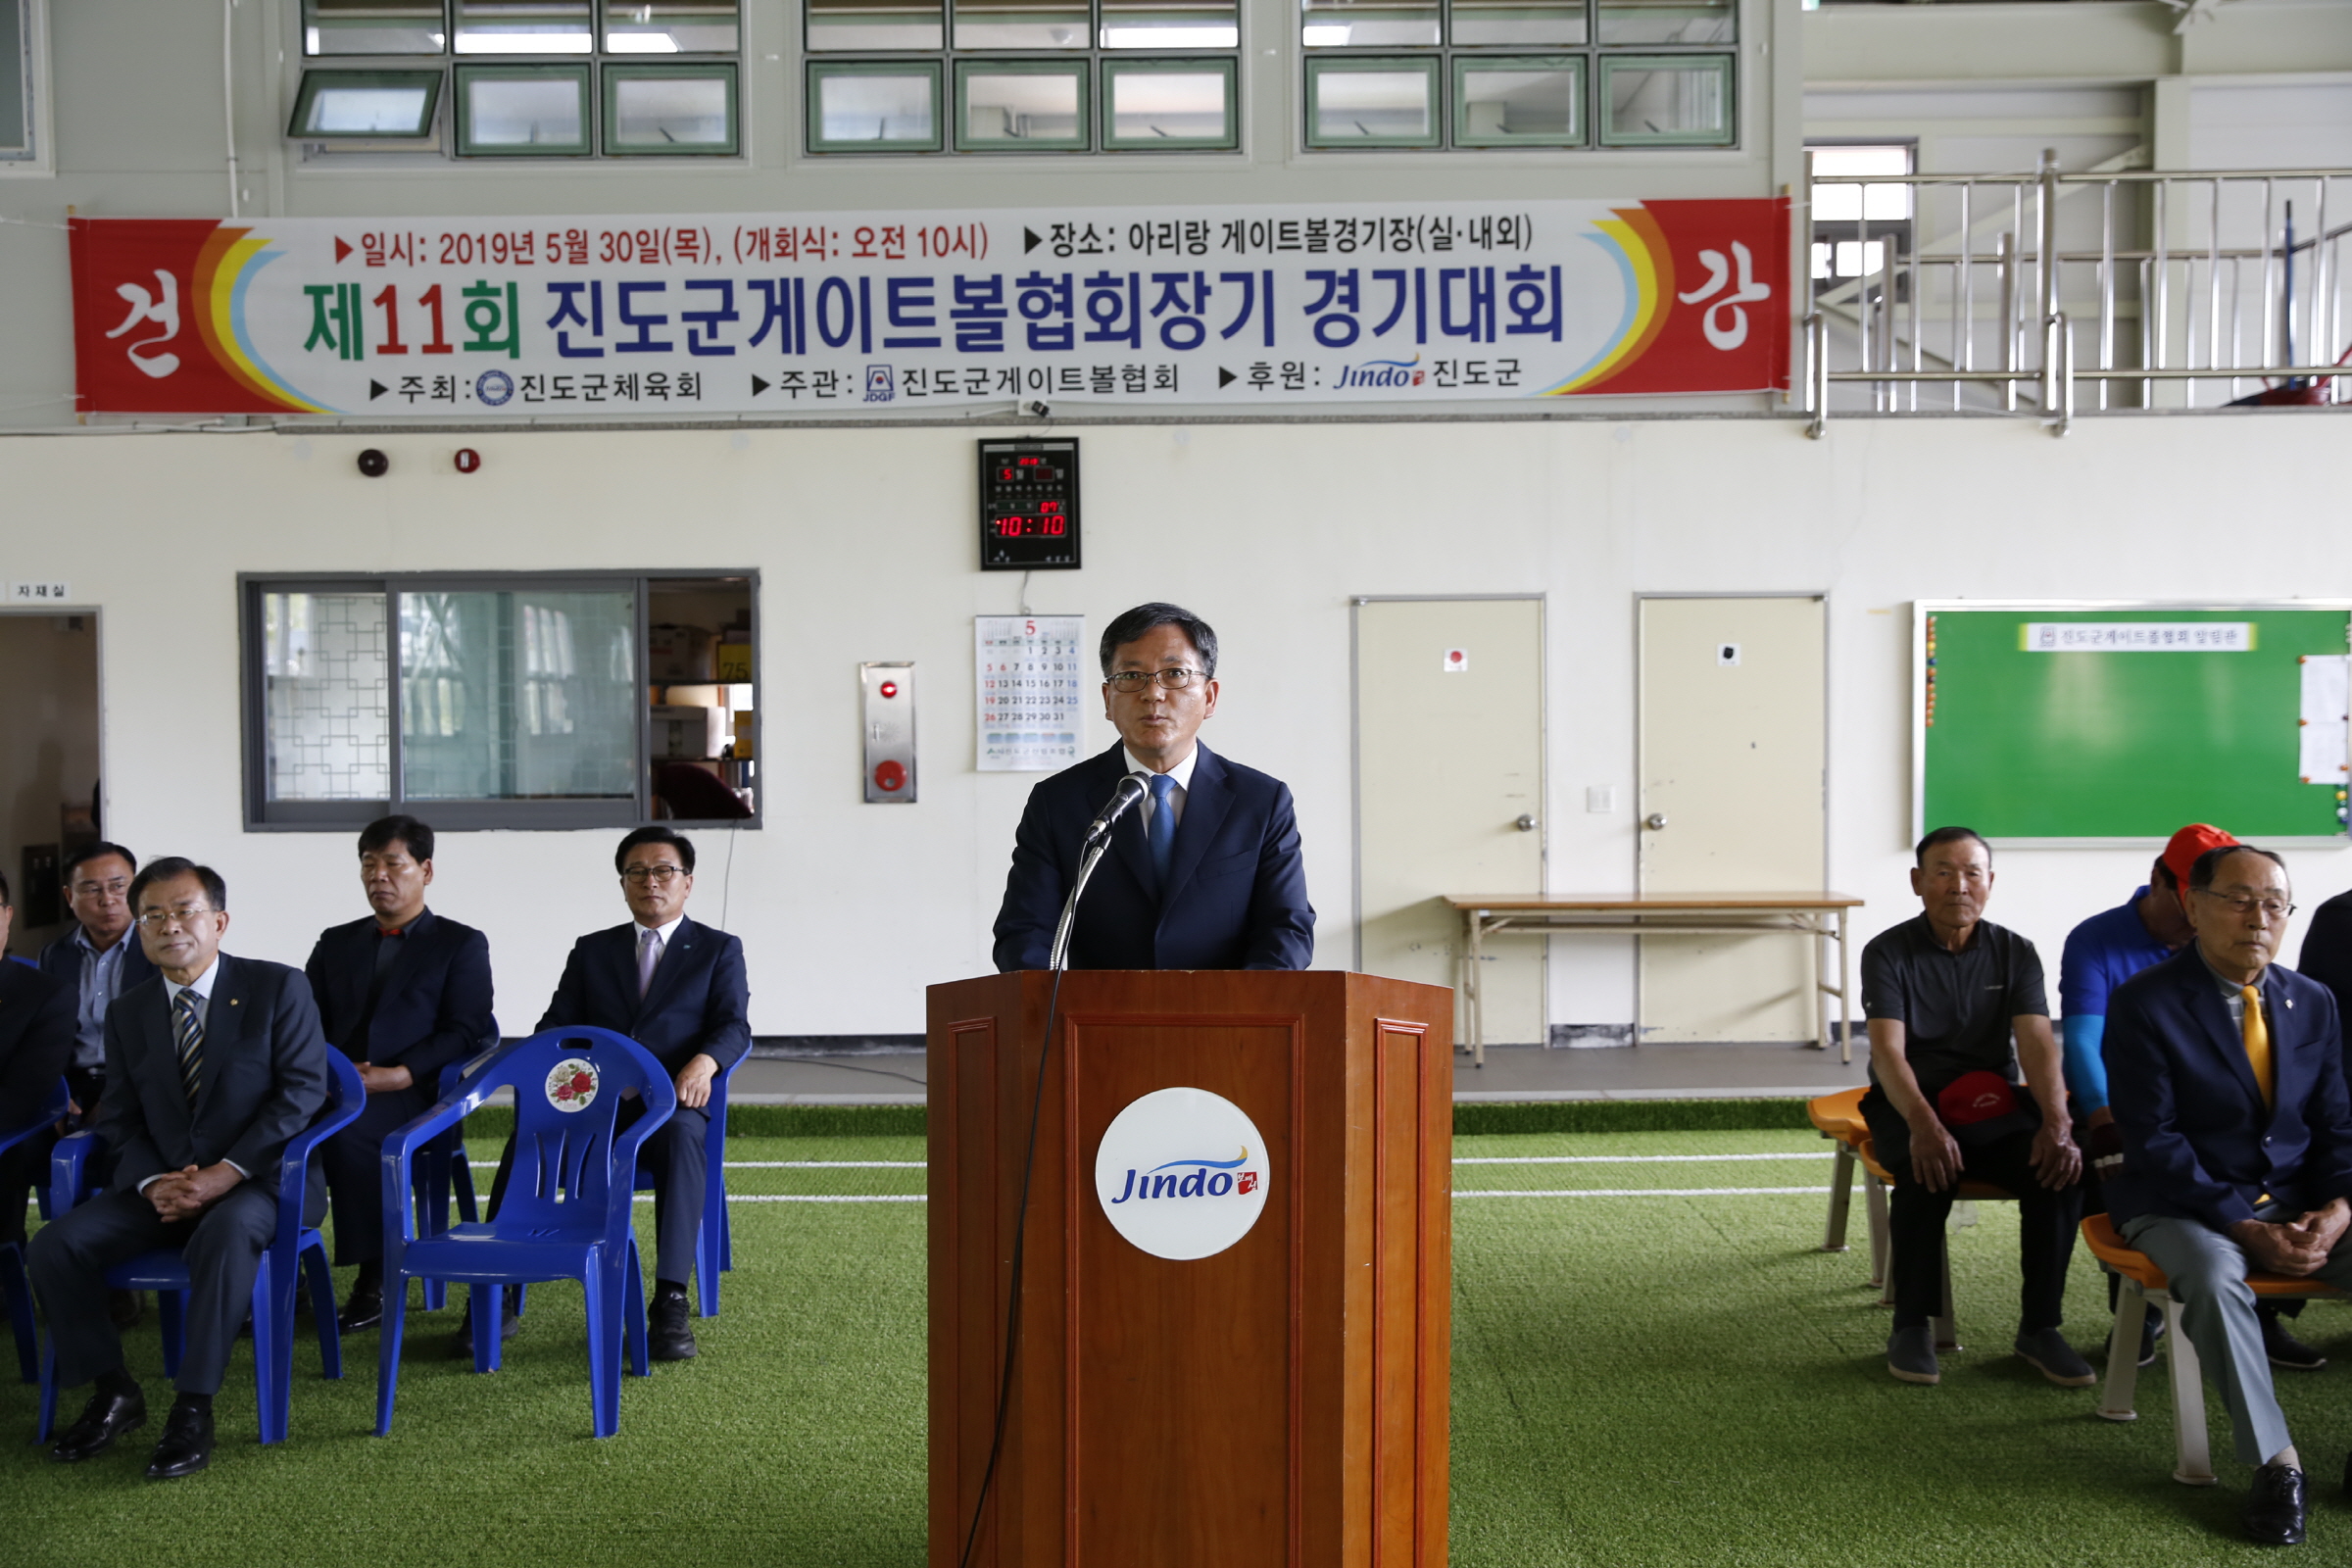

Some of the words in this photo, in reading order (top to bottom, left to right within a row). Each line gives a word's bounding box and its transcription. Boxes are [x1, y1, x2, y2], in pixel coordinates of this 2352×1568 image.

[361, 231, 427, 268] 일시:
[439, 230, 535, 266] 2019년
[546, 228, 589, 266] 5월
[599, 226, 723, 266] 30일(목),
[733, 224, 840, 265] (개회식:
[851, 223, 906, 261] 오전
[917, 221, 989, 261] 10시)
[1050, 221, 1115, 258] 장소:
[1128, 220, 1210, 257] 아리랑
[1677, 239, 1772, 351] 강
[105, 269, 180, 379] 건
[303, 279, 520, 362] 제11회
[546, 267, 1275, 360] 진도군게이트볼협회장기
[1302, 264, 1563, 349] 경기대회
[398, 373, 472, 404] 주최:
[519, 369, 702, 403] 진도군체육회
[780, 368, 854, 400] 주관:
[901, 363, 1179, 397] 진도군게이트볼협회
[1247, 360, 1321, 391] 후원:
[1333, 364, 1410, 390] Jindo
[1433, 358, 1523, 389] 진도군
[862, 391, 896, 403] JDGF
[1004, 468, 1012, 480] 5
[1001, 515, 1064, 536] 10:10
[1025, 620, 1036, 635] 5
[1028, 647, 1033, 656] 1
[1041, 647, 1048, 656] 2
[1055, 647, 1061, 656] 3
[1069, 647, 1076, 656] 4
[1013, 662, 1020, 671] 7
[1027, 662, 1034, 671] 8
[1041, 662, 1048, 671] 9
[1054, 662, 1064, 671] 10
[1067, 662, 1077, 671] 11
[985, 679, 996, 688] 12
[998, 679, 1008, 688] 13
[1011, 679, 1022, 688] 14
[1025, 679, 1036, 688] 15
[1040, 679, 1051, 688] 16
[1054, 679, 1063, 688] 17
[1067, 679, 1078, 688] 18
[985, 696, 996, 705] 19
[998, 696, 1009, 705] 20
[1011, 696, 1022, 705] 21
[1025, 696, 1037, 705] 22
[1039, 696, 1051, 705] 23
[1053, 696, 1064, 705] 24
[1066, 696, 1078, 705] 25
[985, 712, 996, 721] 26
[998, 712, 1009, 721] 27
[1011, 712, 1023, 721] 28
[1025, 712, 1037, 721] 29
[1039, 712, 1051, 721] 30
[1053, 712, 1064, 721] 31
[1111, 1168, 1233, 1203] Jindo
